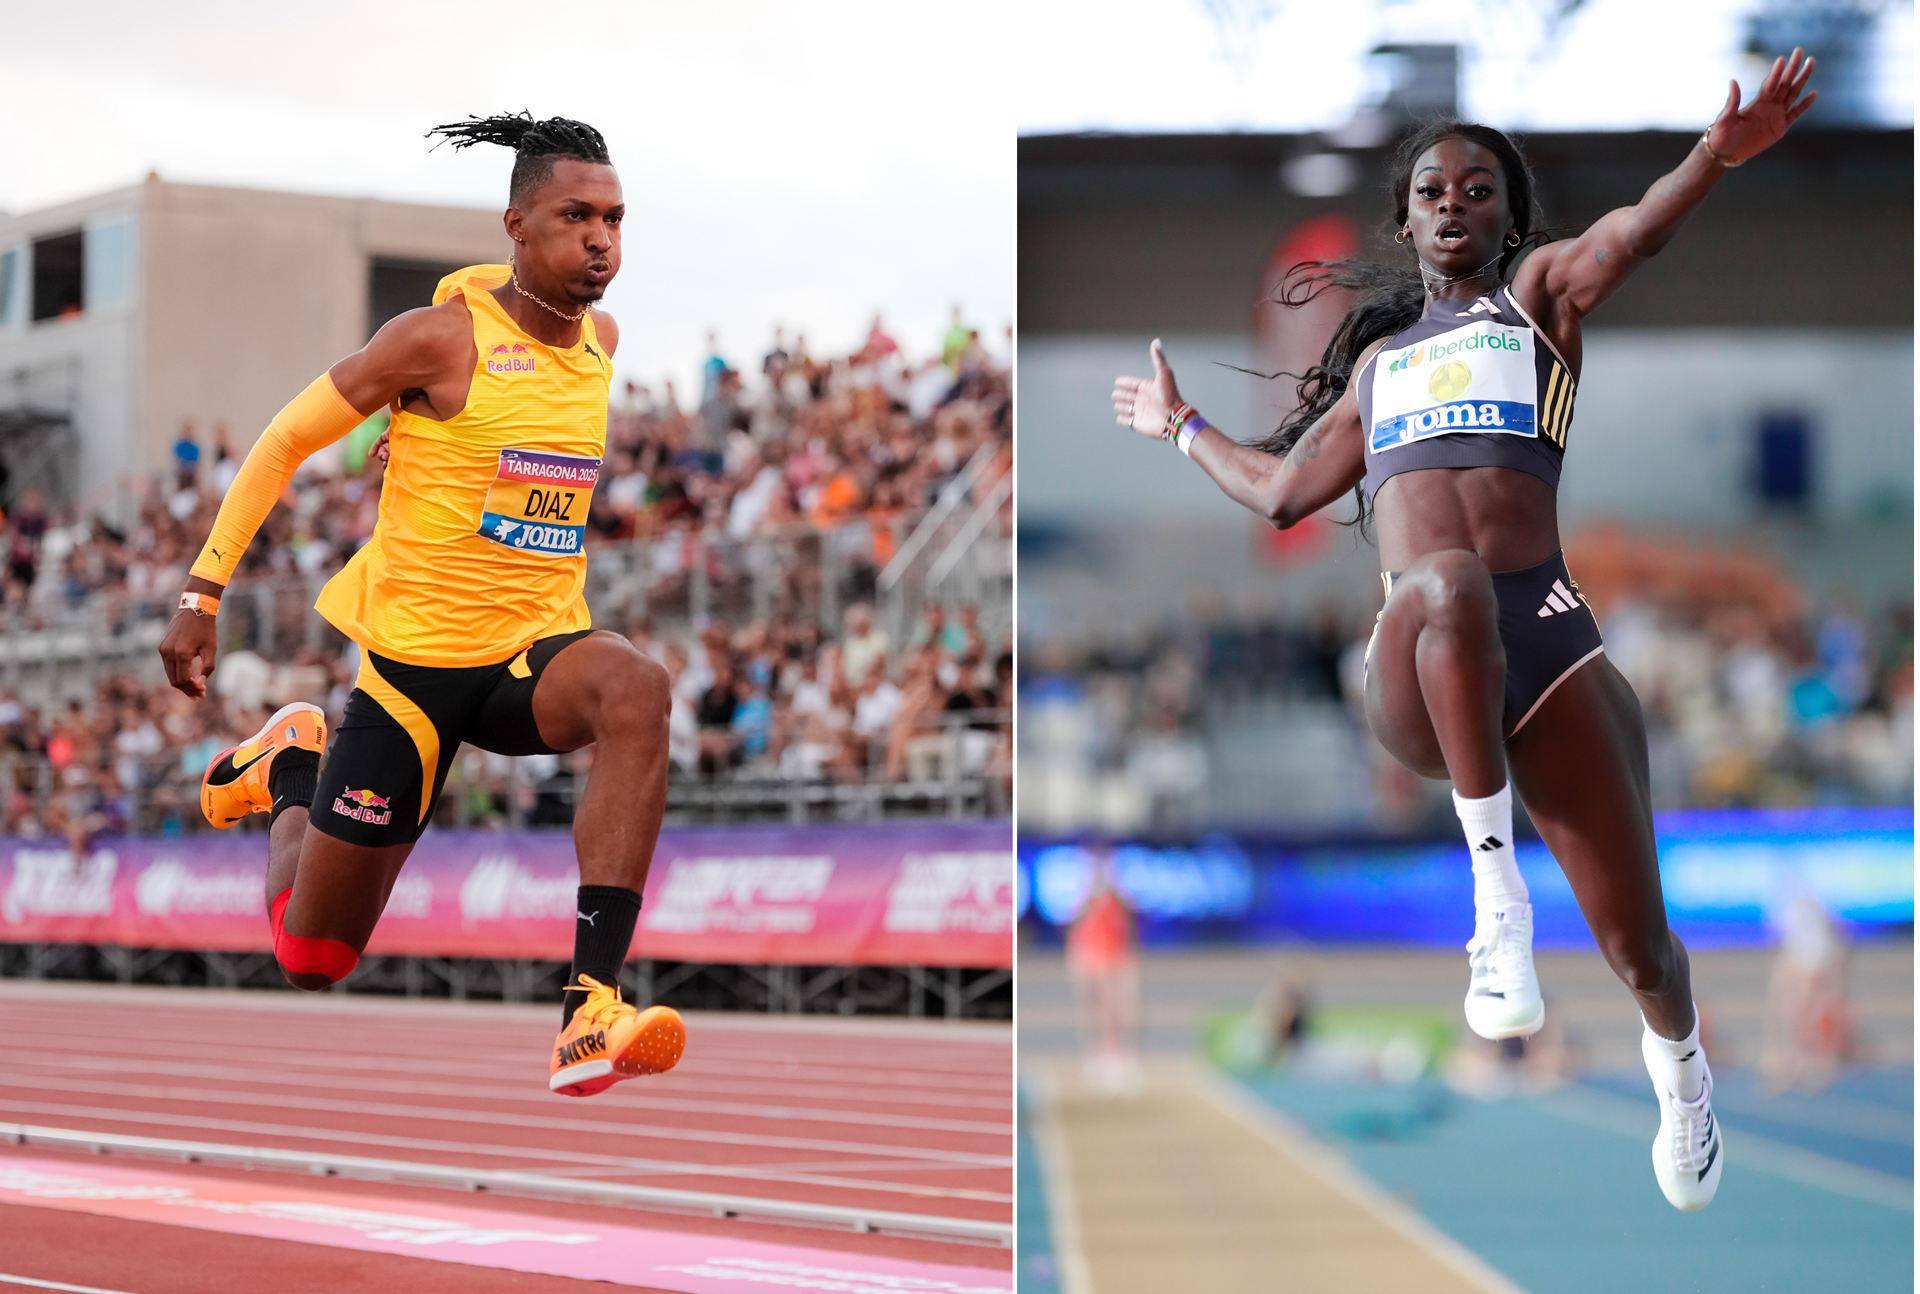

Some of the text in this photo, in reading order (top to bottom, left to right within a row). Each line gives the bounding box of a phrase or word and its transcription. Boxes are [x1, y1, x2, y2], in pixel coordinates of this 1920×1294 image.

[1429, 331, 1521, 362] Iberdrola
[487, 358, 535, 372] Red Bull
[507, 459, 598, 482] TARRAGONA 2025
[524, 489, 574, 520] DIAZ
[332, 797, 392, 825] Red Bull
[557, 1030, 606, 1068] NITRO
